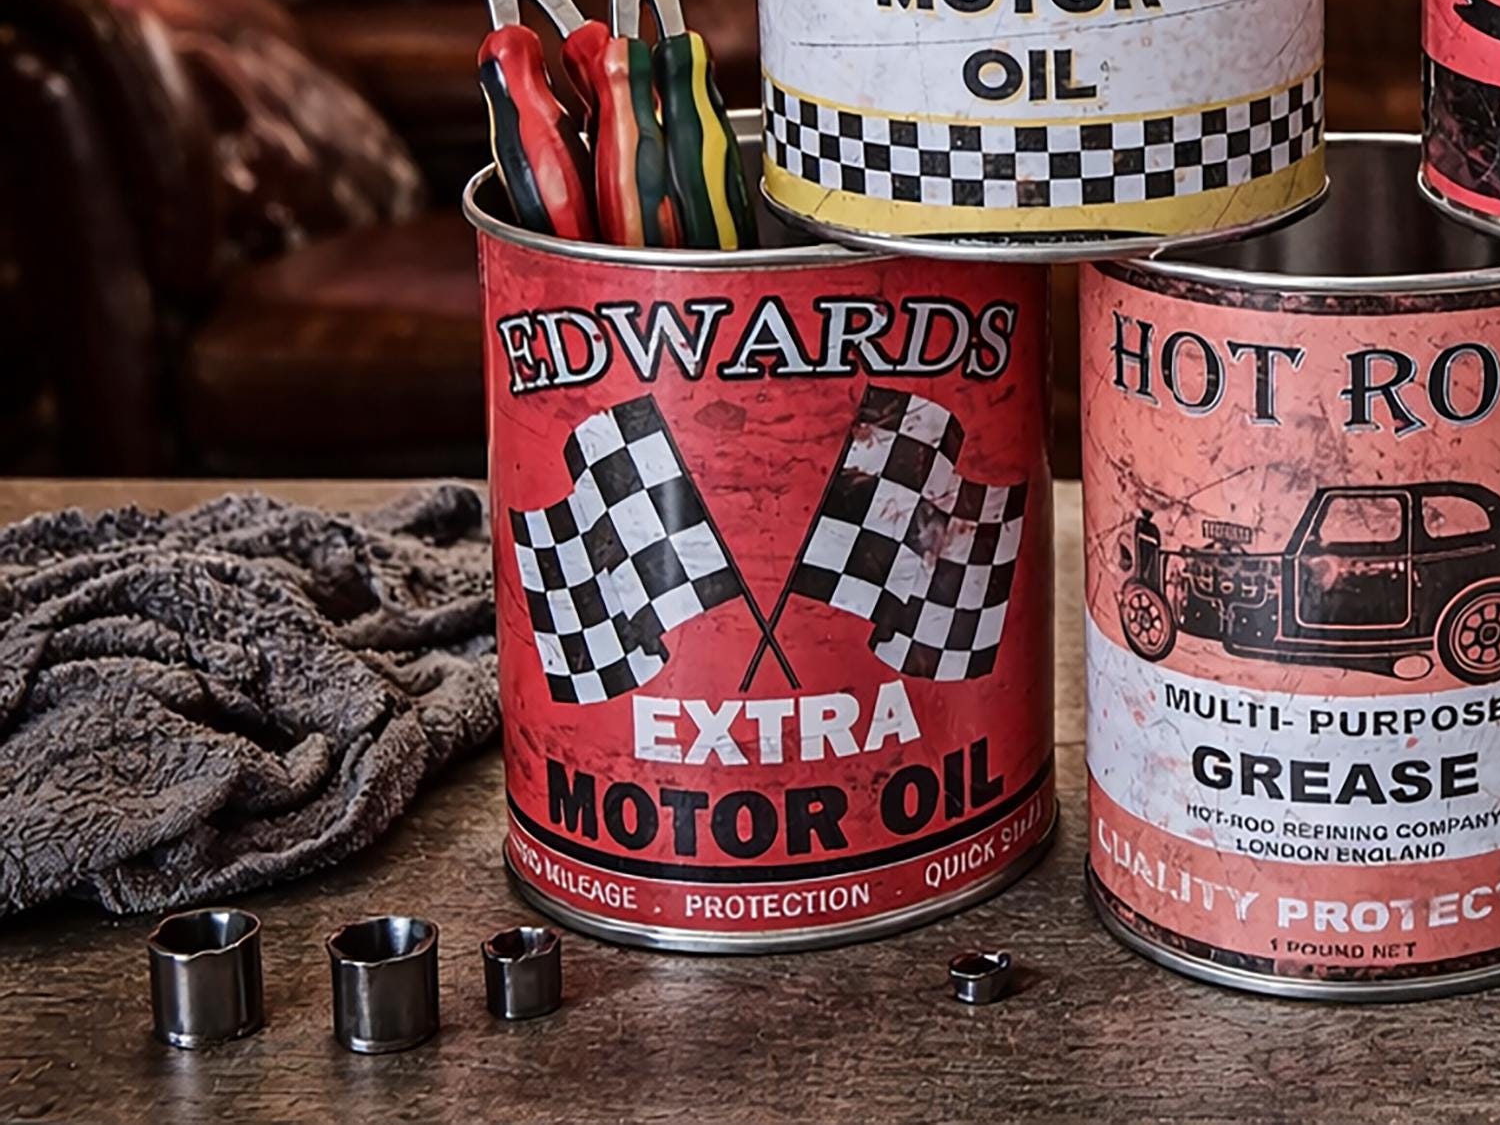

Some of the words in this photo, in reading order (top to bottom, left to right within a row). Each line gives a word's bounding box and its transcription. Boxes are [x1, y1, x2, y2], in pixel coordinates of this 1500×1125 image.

[962, 48, 1098, 102] OIL
[496, 296, 1018, 394] EDWARDS
[1111, 310, 1305, 426] HOT
[632, 679, 920, 766] EXTRA
[547, 757, 850, 859] MOTOR
[880, 737, 1005, 837] OIL
[1191, 744, 1480, 806] GREASE
[1236, 837, 1329, 862] LONDON
[1337, 841, 1446, 864] ENGLAND
[1283, 821, 1388, 842] REFINING
[685, 883, 871, 920] PROTECTION
[925, 836, 996, 888] QUICK
[1287, 940, 1365, 959] POUND
[1372, 941, 1418, 959] NET
